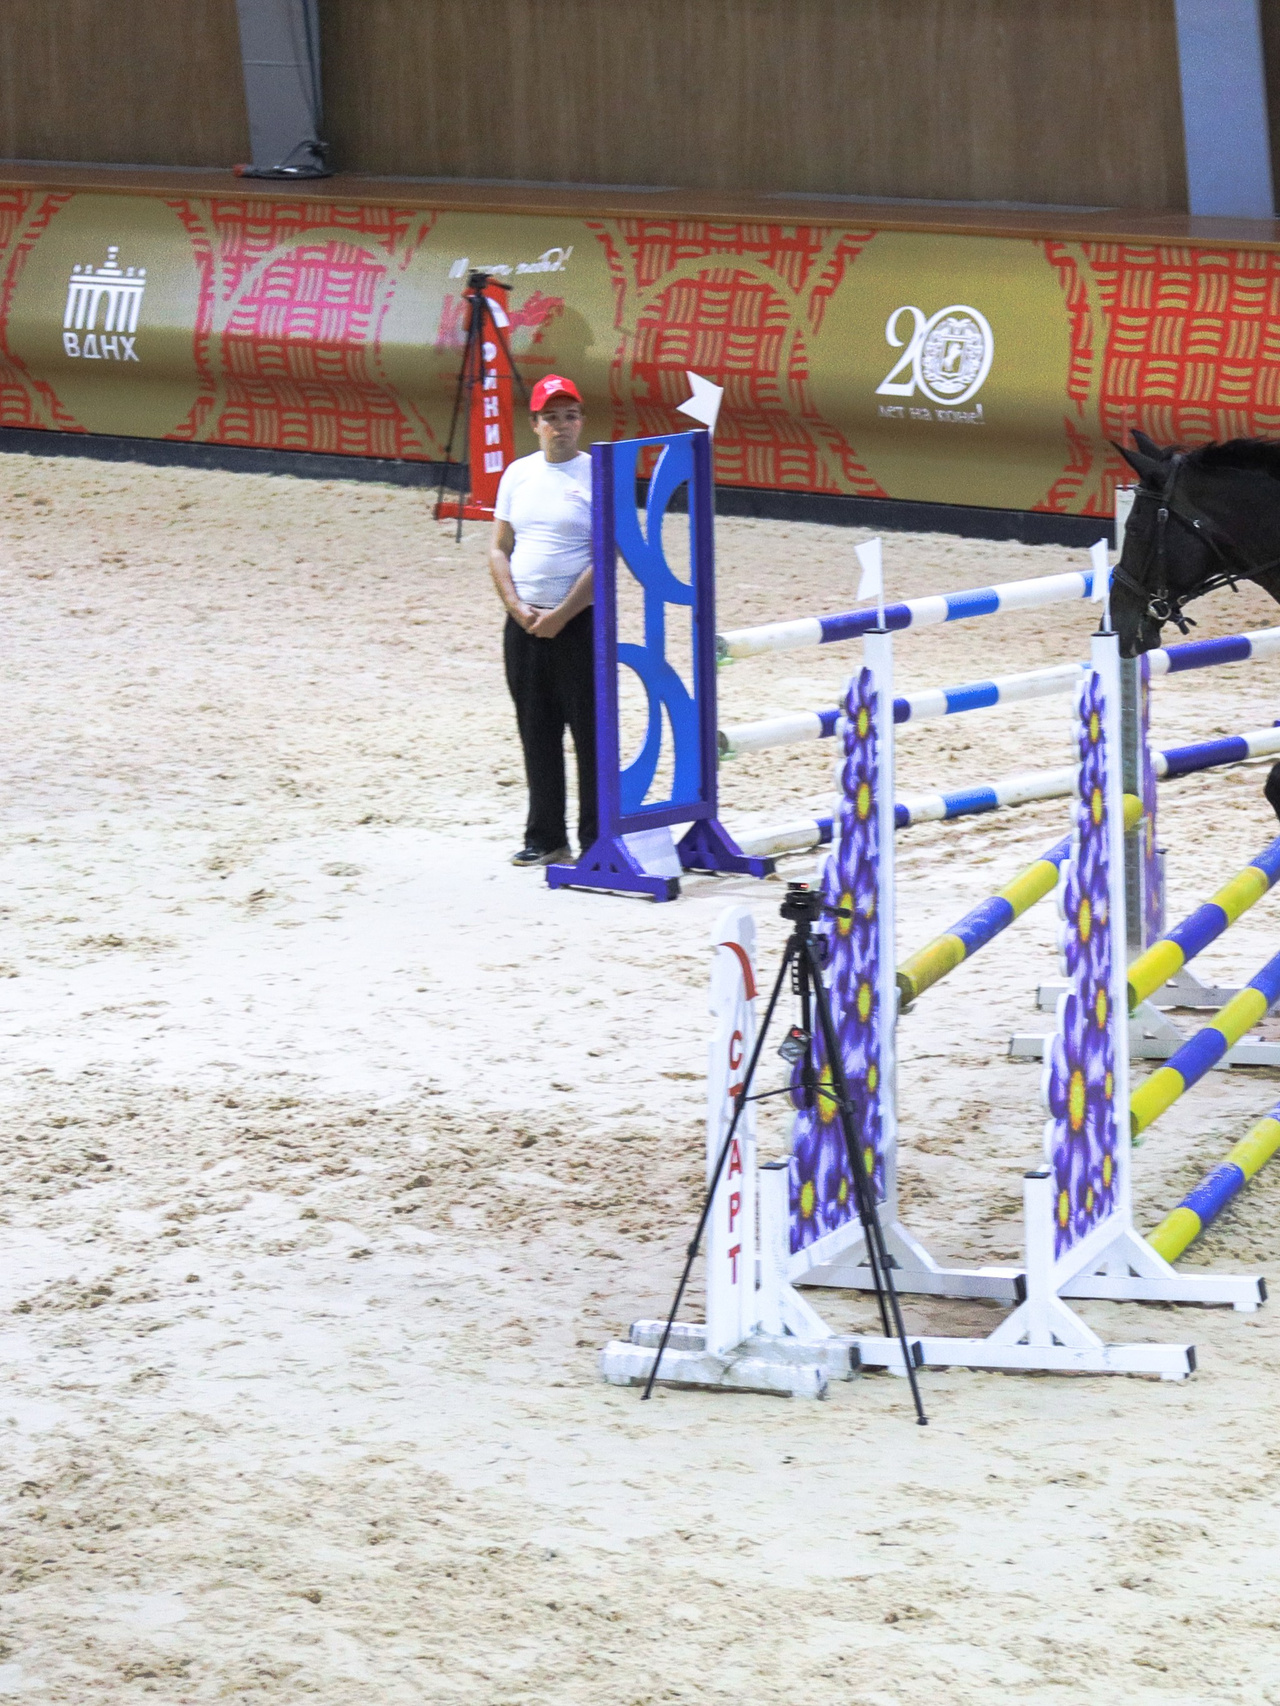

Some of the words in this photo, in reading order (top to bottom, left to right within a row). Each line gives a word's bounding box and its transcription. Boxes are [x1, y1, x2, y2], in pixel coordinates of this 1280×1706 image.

[62, 332, 139, 361] ВДНХ
[875, 305, 994, 405] 20
[728, 1029, 744, 1286] СТАРТ
